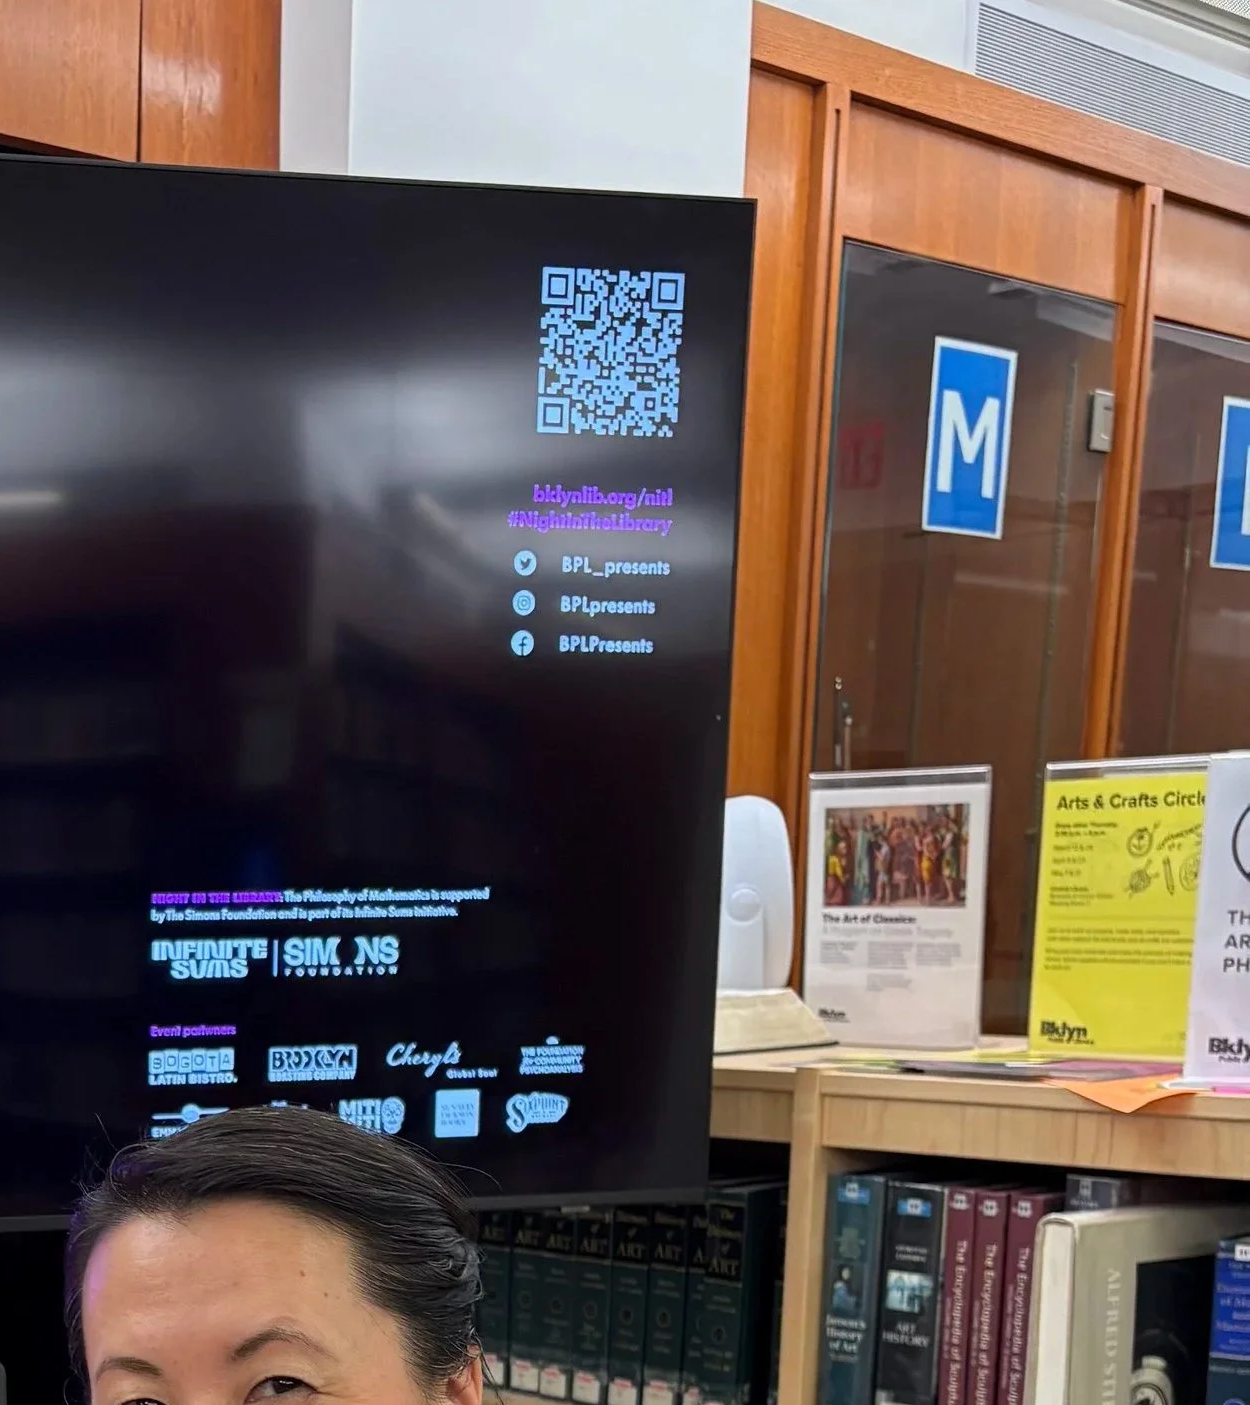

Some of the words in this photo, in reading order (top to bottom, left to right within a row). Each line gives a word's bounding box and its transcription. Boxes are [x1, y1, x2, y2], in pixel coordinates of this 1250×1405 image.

[937, 388, 1000, 499] M
[508, 511, 672, 536] #NightInTheLibrary
[562, 556, 670, 577] BPL_presents
[561, 595, 655, 617] BPLpresents
[560, 635, 653, 653] BPLPresents
[1057, 795, 1089, 810] Arts
[1094, 794, 1104, 809] &
[1109, 793, 1158, 808] Crafts
[152, 892, 188, 904] NIGHT
[191, 892, 207, 904] IN
[209, 892, 230, 903] THE
[284, 890, 302, 902] The
[303, 889, 357, 904] Philosophy
[369, 889, 430, 902] Mathematics
[439, 887, 490, 903] supported
[151, 909, 166, 924] by
[166, 909, 184, 921] The
[185, 909, 220, 921] Simons
[221, 908, 277, 921] Foundation
[278, 908, 298, 920] and
[387, 906, 413, 917] Sums
[822, 913, 840, 923] The
[843, 914, 858, 923] Art
[860, 915, 871, 923] of
[151, 938, 268, 961] INFINITE
[170, 959, 249, 979] SUMS
[285, 966, 398, 977] FOUNDATION
[150, 1025, 181, 1037] Event
[1041, 1021, 1087, 1042] Bklyn
[151, 1053, 233, 1069] BOGOTA
[149, 1074, 187, 1085] LATIN
[955, 1240, 968, 1263] The
[984, 1243, 998, 1268] The
[1017, 1247, 1029, 1270] The
[708, 1256, 739, 1276] ART
[951, 1265, 966, 1345] Encyclopedia
[979, 1269, 996, 1350] Encyclopedia
[1012, 1272, 1028, 1352] Encyclopedia
[1104, 1270, 1122, 1356] ALFRED
[825, 1327, 863, 1341] History
[895, 1323, 917, 1335] ART
[882, 1331, 930, 1348] HISTORY
